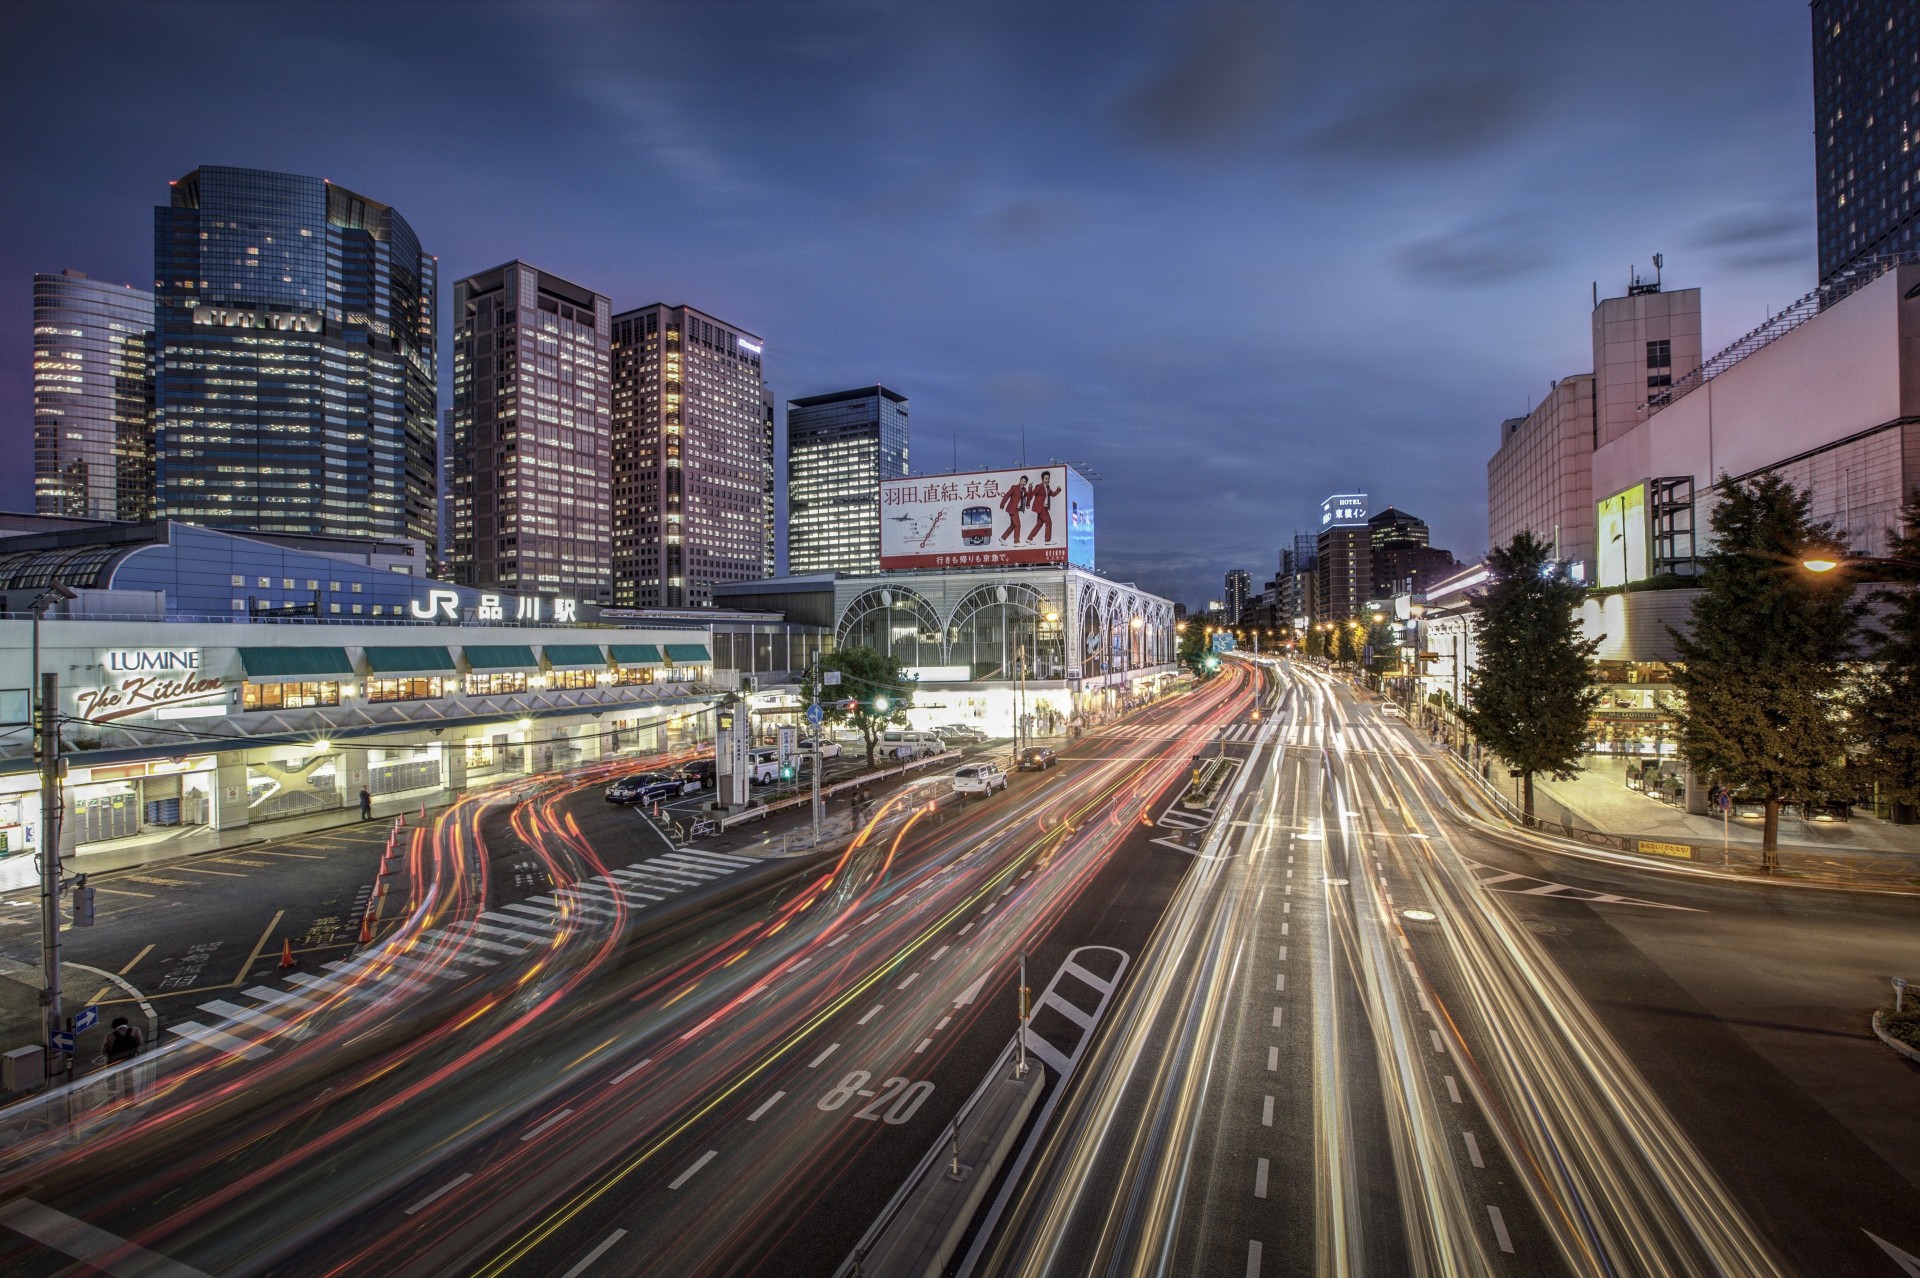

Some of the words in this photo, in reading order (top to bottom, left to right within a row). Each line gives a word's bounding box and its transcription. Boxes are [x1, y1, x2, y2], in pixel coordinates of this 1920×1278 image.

[883, 479, 1006, 506] 羽田、直結、京急。
[1335, 508, 1367, 519] 東横イン
[936, 553, 1009, 565] 行きも帰りも京急で。
[411, 589, 459, 619] JR
[478, 594, 577, 622] 品川駅
[111, 651, 199, 671] LUMINE
[78, 686, 122, 718] The
[122, 671, 224, 705] Kitchen
[817, 1070, 936, 1125] 8-20
